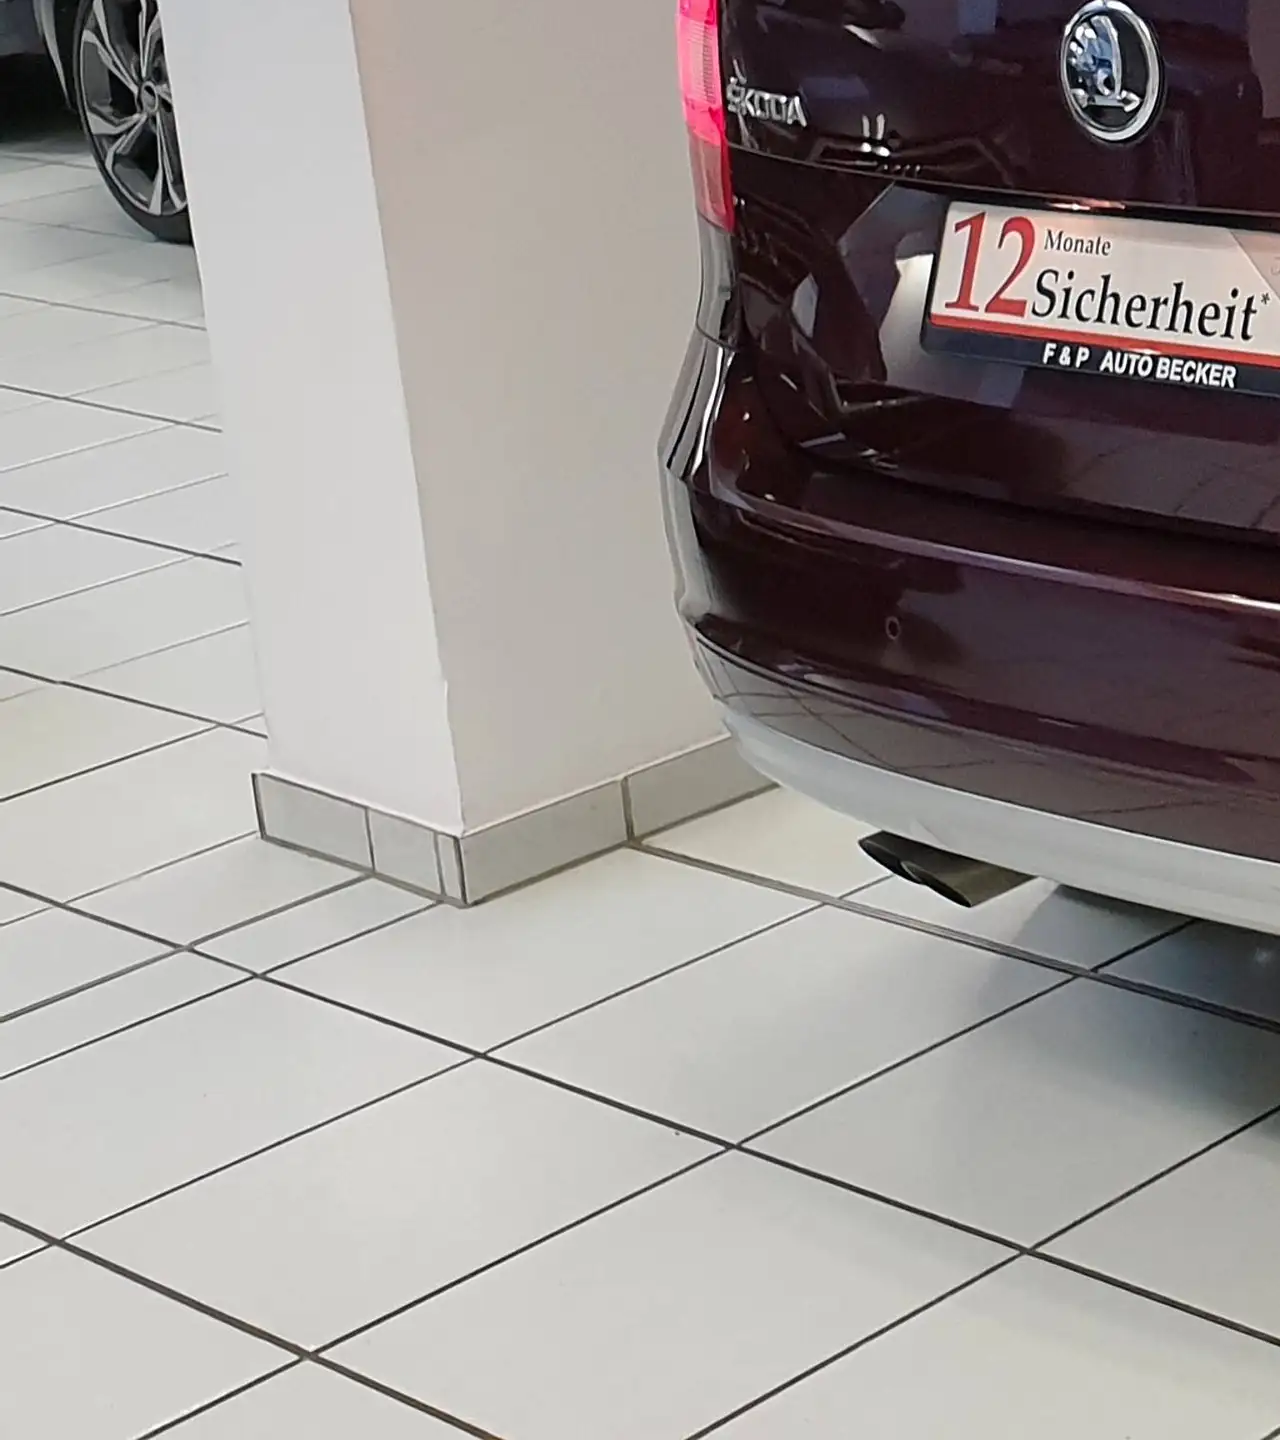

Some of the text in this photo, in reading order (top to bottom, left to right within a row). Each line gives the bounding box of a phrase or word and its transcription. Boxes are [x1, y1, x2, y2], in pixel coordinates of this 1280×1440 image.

[944, 211, 1036, 319] 12
[1044, 228, 1112, 258] Monate
[1043, 343, 1236, 389] F & P AUTO BECKER
